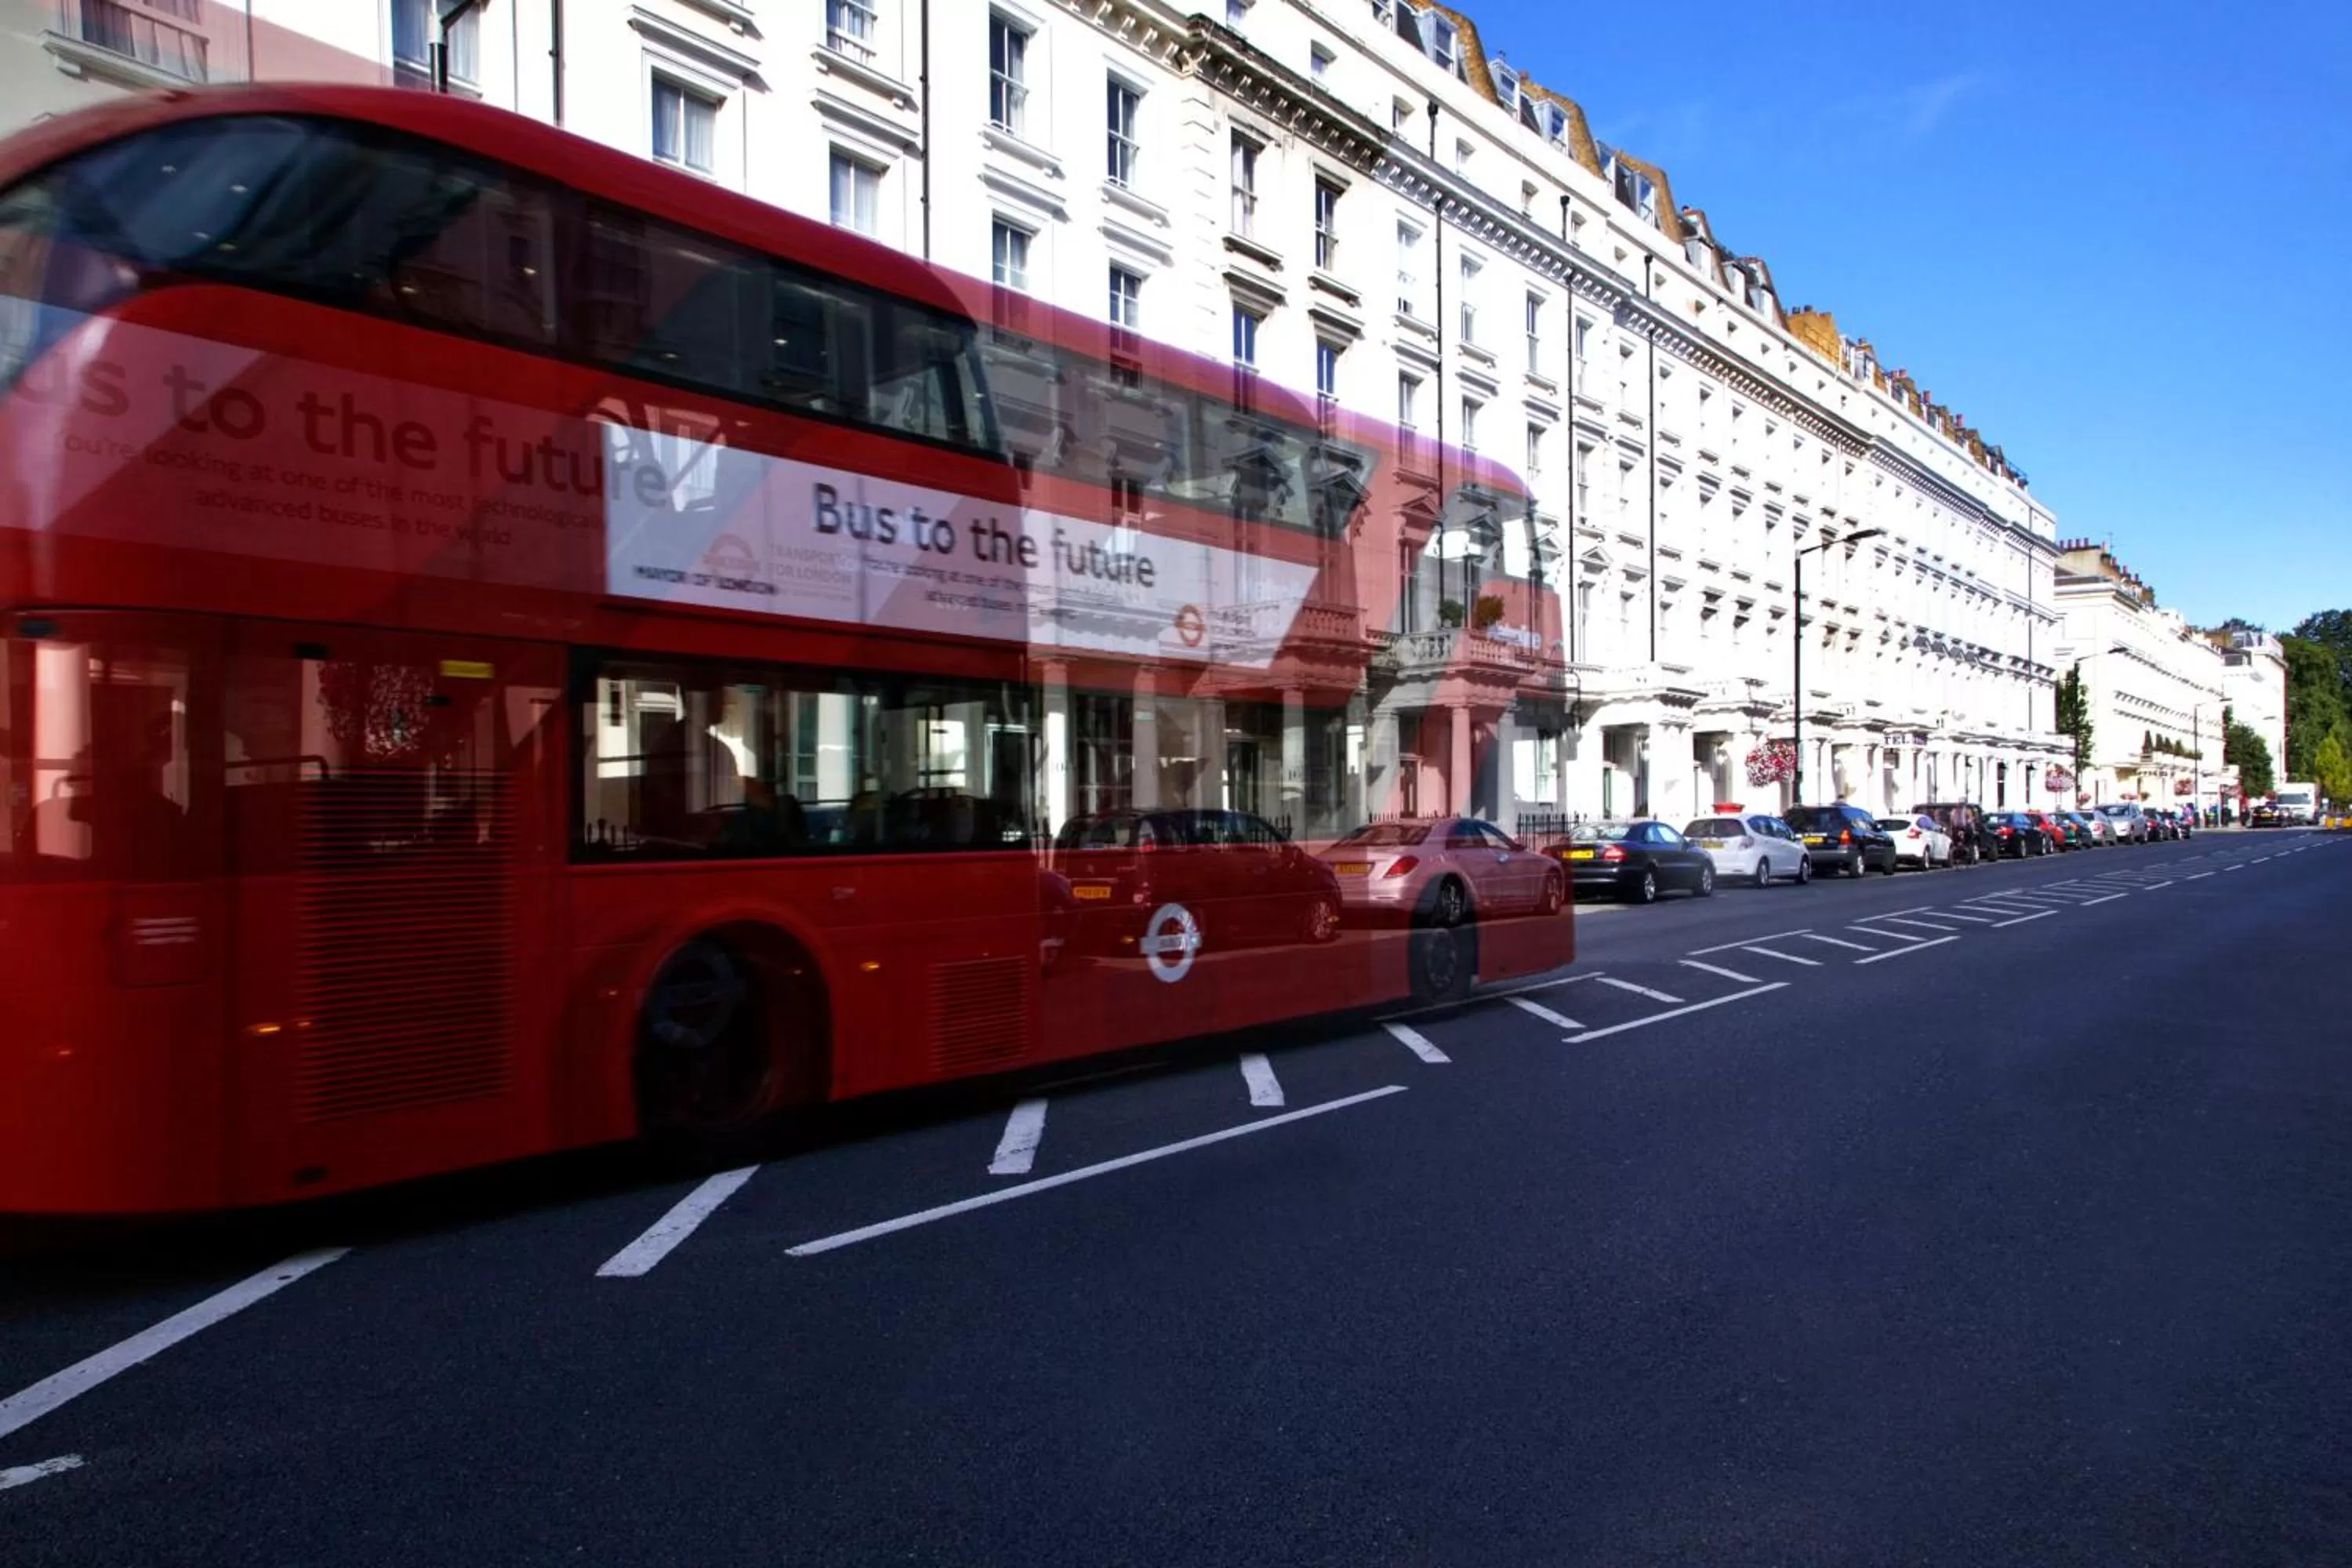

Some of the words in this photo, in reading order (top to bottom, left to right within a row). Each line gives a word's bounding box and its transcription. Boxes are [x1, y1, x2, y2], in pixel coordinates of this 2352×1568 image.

[55, 431, 136, 461] ou're
[249, 463, 275, 482] at
[281, 466, 326, 489] one
[163, 364, 265, 440] to
[296, 390, 438, 470] the
[463, 416, 669, 508] future
[318, 502, 384, 529] buses
[812, 483, 898, 544] Bus
[910, 506, 956, 555] to
[969, 517, 1039, 568] the
[1051, 528, 1155, 587] future
